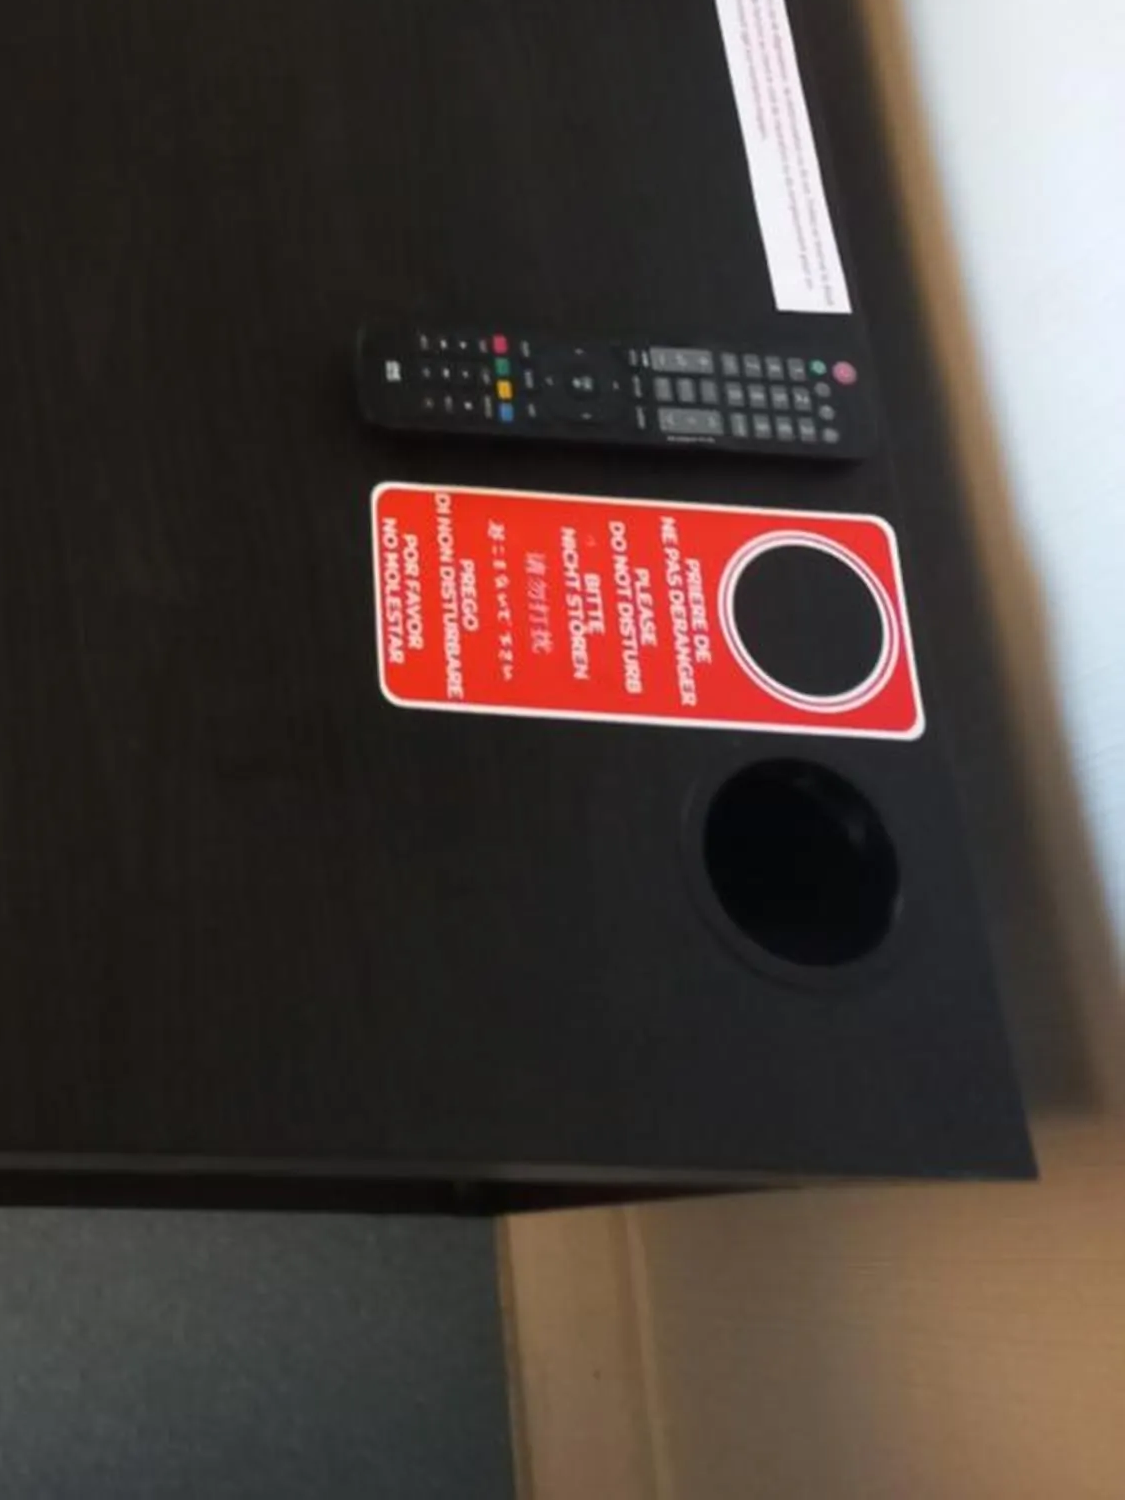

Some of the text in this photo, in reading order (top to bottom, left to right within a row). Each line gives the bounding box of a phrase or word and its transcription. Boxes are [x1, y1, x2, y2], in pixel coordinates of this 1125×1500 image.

[382, 518, 404, 664] NO MOLESTAR
[402, 534, 423, 649] POR FAVOR
[435, 493, 463, 700] DI NON DISTURBARE
[459, 559, 478, 631] PREGO
[523, 552, 553, 654] 请勿打扰
[561, 527, 580, 590] NICHT
[584, 573, 605, 635] BITTE
[608, 521, 642, 694] DO NOT DISTURB
[634, 568, 657, 647] PLEASE
[659, 516, 696, 706] NE PAS DERANGER
[685, 558, 712, 664] PRIERE DE
